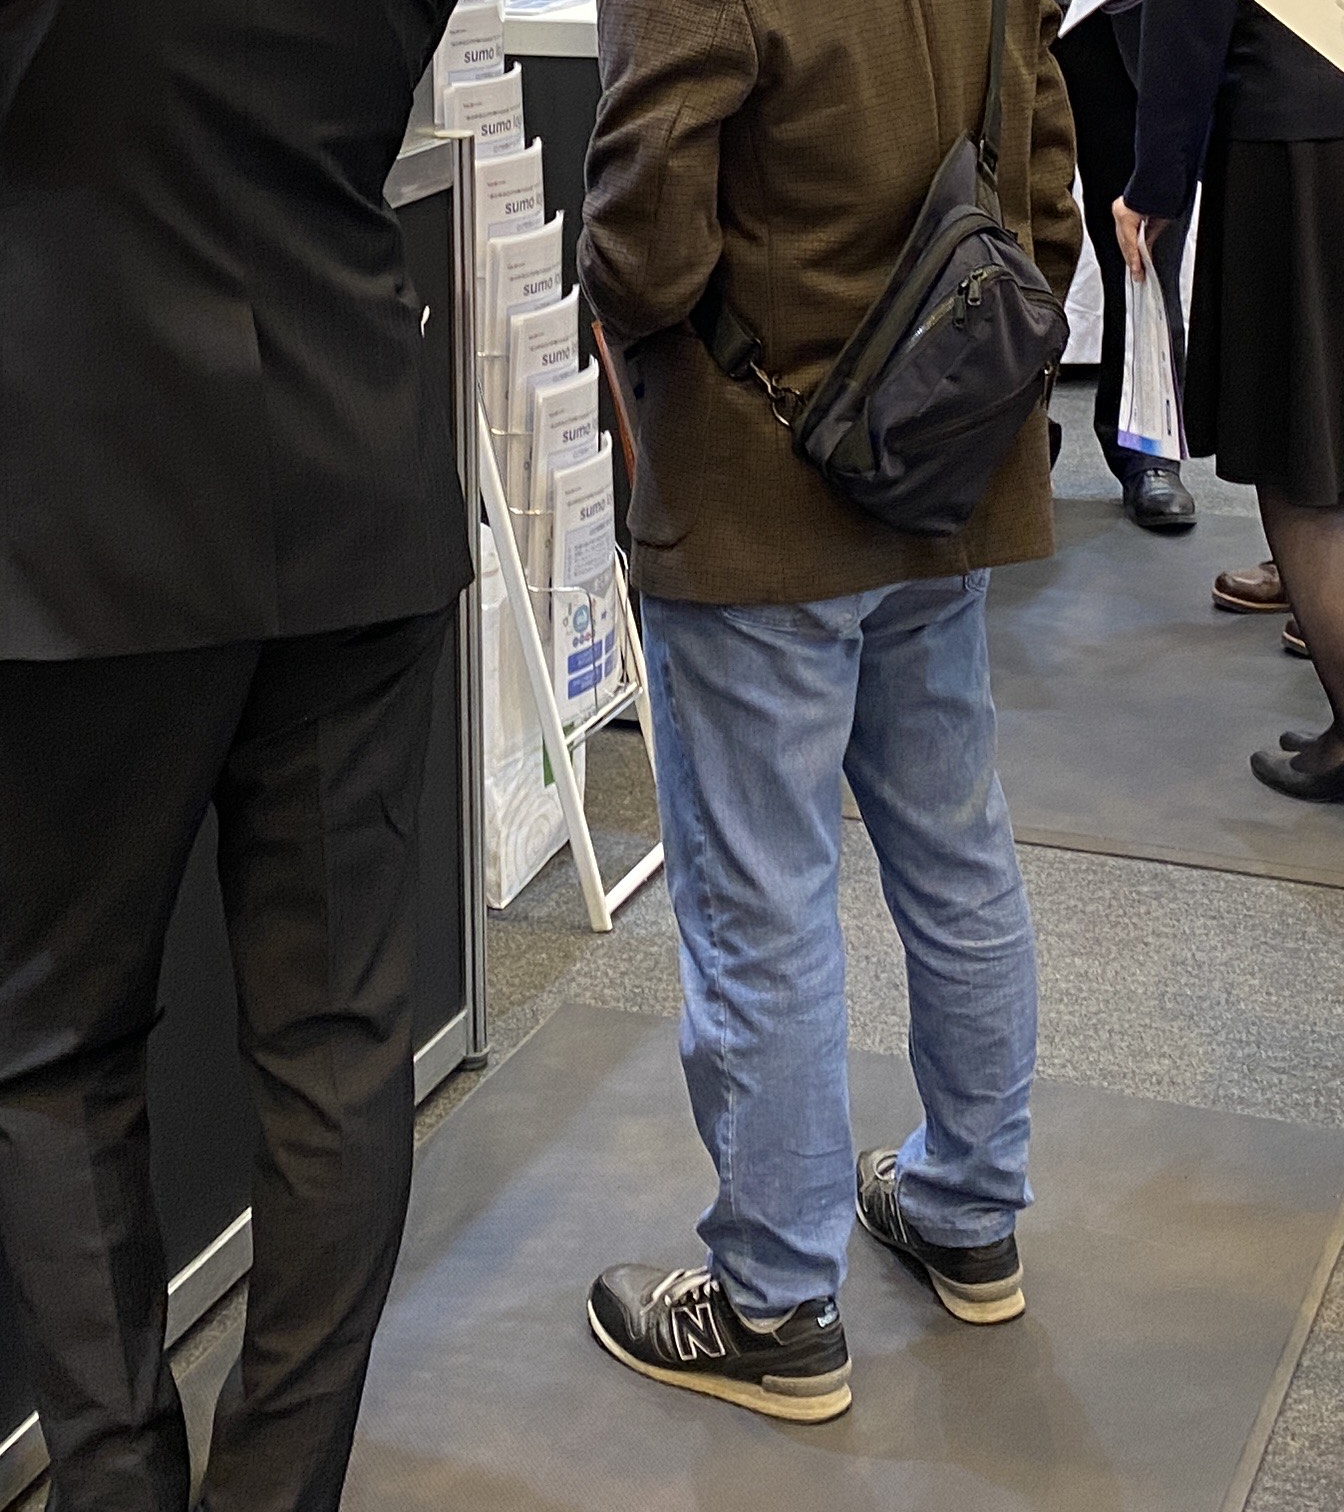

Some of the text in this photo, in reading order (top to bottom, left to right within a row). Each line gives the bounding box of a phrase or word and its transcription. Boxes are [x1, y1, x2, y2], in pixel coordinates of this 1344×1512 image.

[464, 47, 494, 64] sumo
[481, 119, 511, 137] sumo
[505, 197, 534, 215] sumo
[523, 278, 552, 297] sumo
[542, 347, 570, 367] sumo
[562, 422, 591, 443] sumo
[580, 499, 605, 520] sumo
